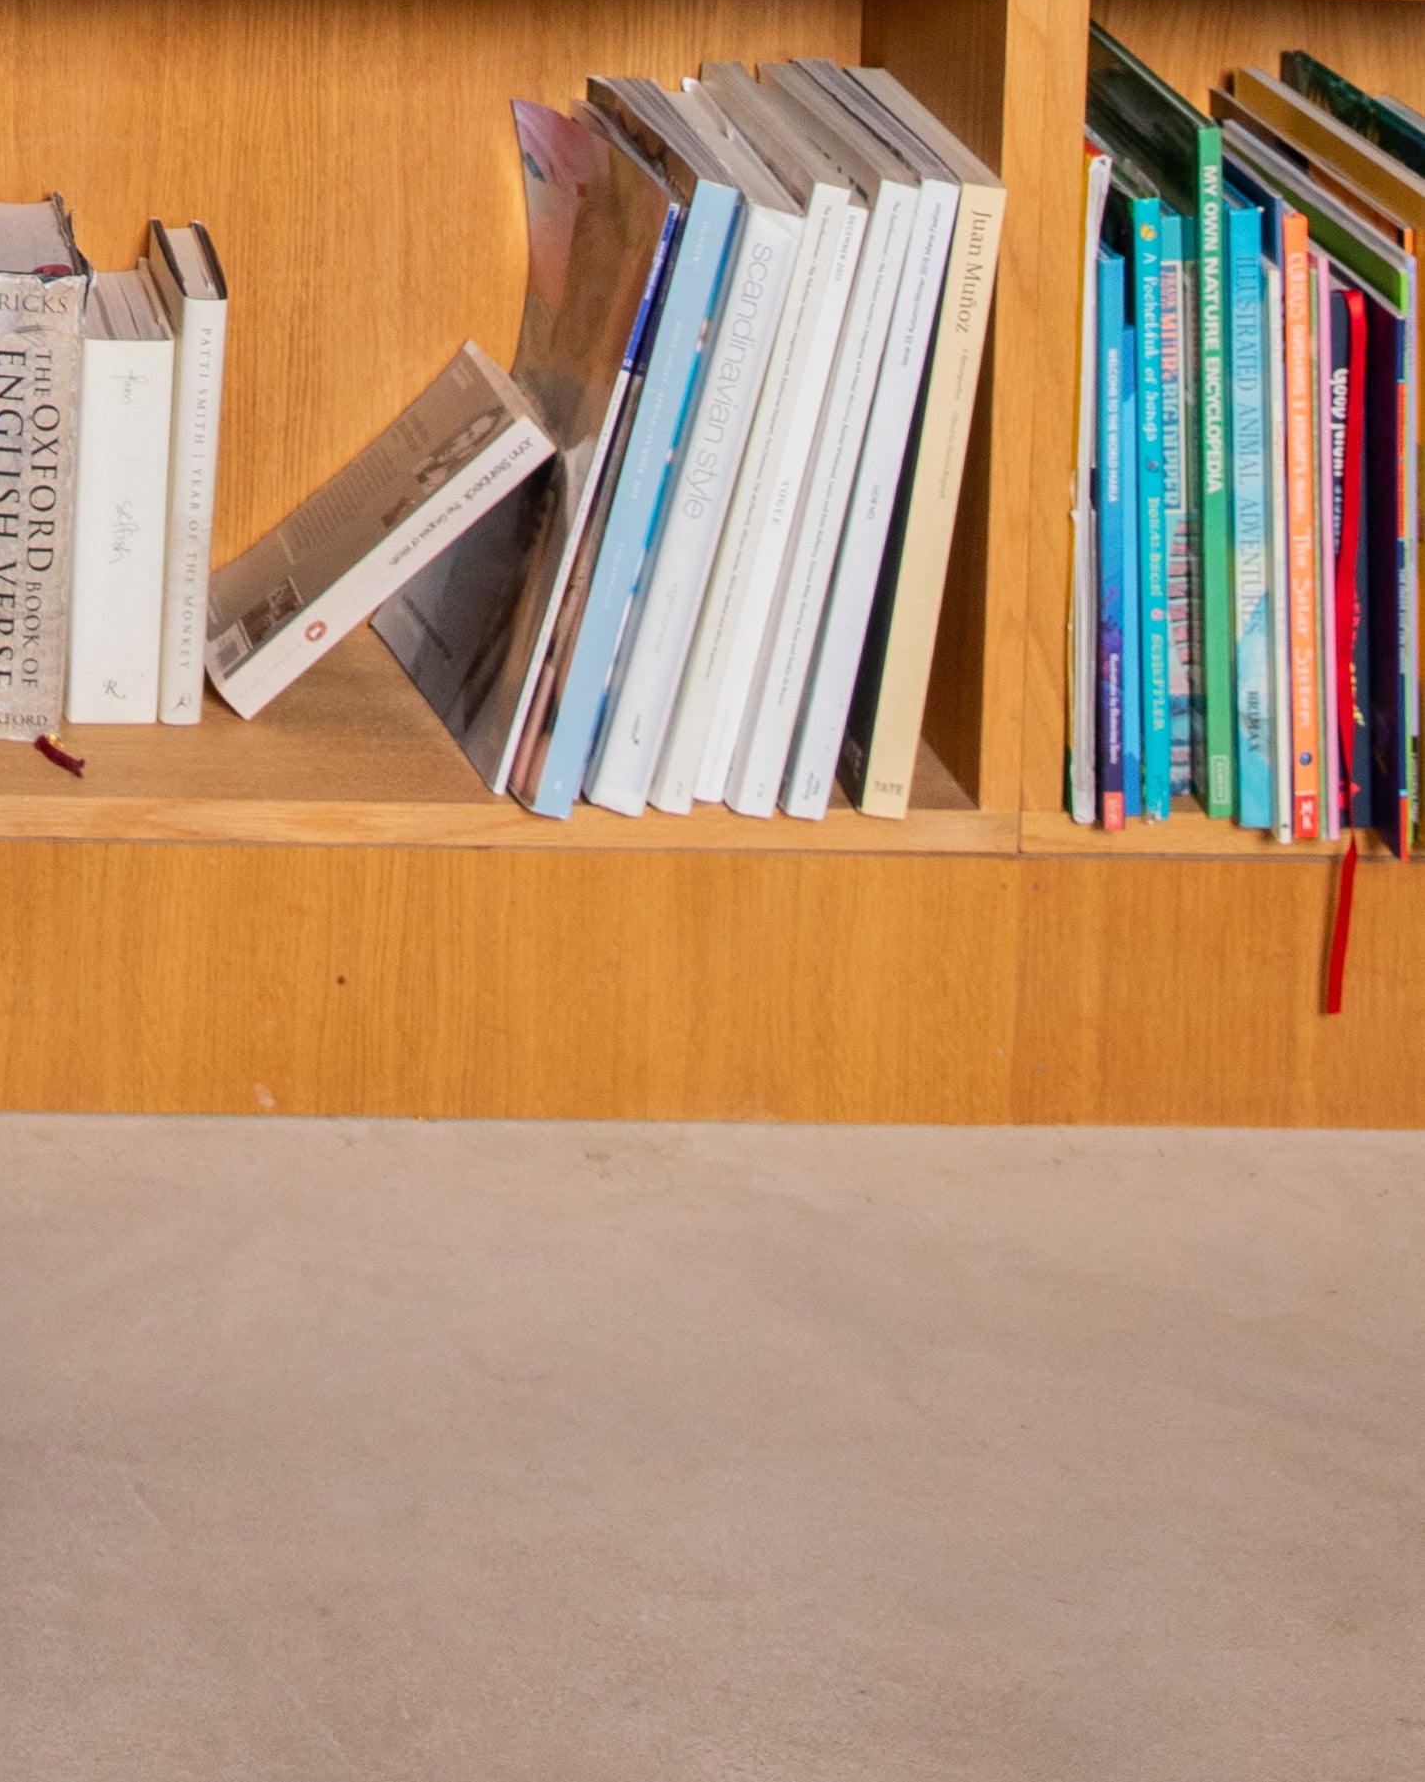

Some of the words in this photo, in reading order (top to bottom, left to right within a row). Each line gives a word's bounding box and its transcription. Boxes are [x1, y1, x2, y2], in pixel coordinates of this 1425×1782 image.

[1203, 165, 1218, 196] MY
[1202, 206, 1218, 250] OWN
[1203, 259, 1220, 349] NATURE
[34, 350, 53, 397] THE
[702, 241, 780, 444] scandinavian
[1203, 356, 1220, 493] ENCYCLOPEDIA
[27, 404, 60, 571] OXFORD
[681, 449, 724, 520] style
[24, 581, 41, 648] BOOK
[21, 657, 38, 688] OF
